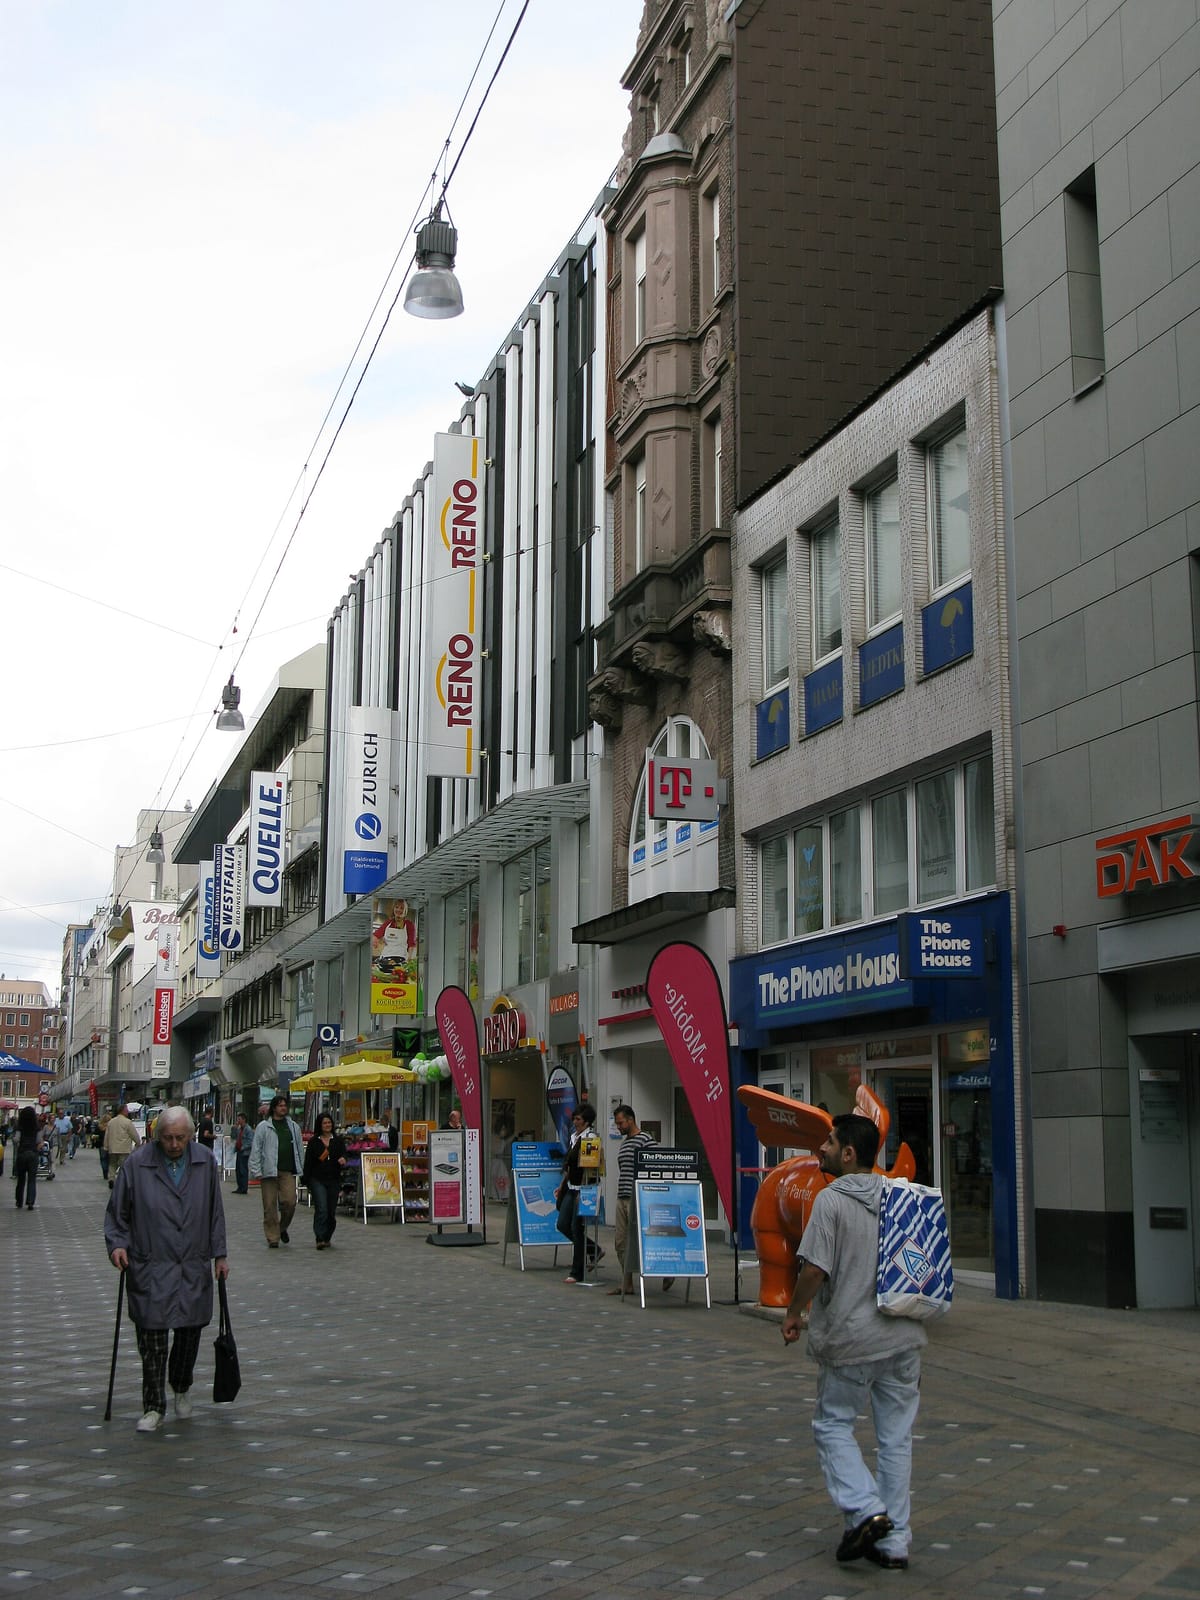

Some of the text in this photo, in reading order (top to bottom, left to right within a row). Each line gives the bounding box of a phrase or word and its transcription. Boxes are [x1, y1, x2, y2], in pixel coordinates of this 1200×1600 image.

[452, 479, 478, 569] RENO
[447, 633, 474, 728] RENO
[362, 733, 378, 806] ZURICH
[1096, 814, 1195, 898] DAK
[222, 846, 235, 925] WESTFALIA
[920, 919, 951, 933] The
[920, 936, 971, 950] Phone
[921, 952, 972, 967] House
[550, 993, 578, 1014] VILLAGE
[758, 972, 789, 1007] The
[790, 964, 844, 1002] Phone
[157, 991, 169, 1042] Cornelsen
[484, 1008, 520, 1054] RENO
[282, 1050, 305, 1062] debitel
[768, 1107, 799, 1128] DAK
